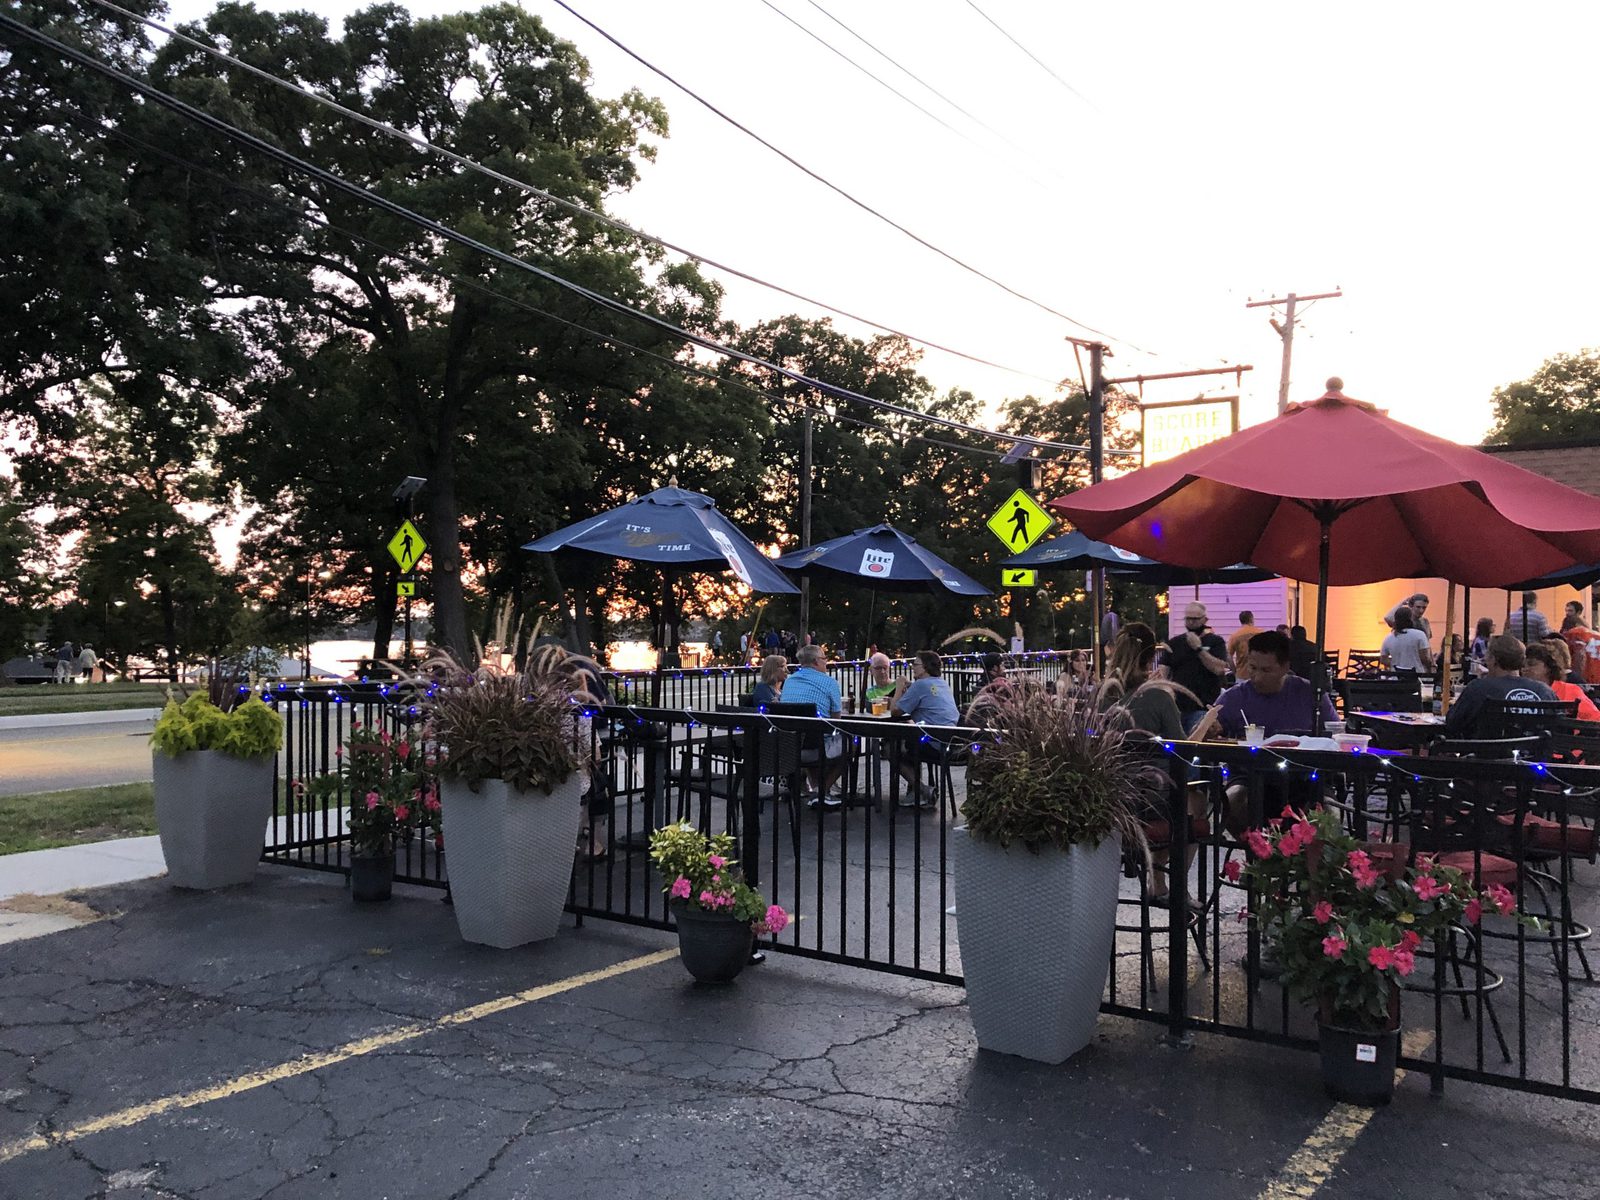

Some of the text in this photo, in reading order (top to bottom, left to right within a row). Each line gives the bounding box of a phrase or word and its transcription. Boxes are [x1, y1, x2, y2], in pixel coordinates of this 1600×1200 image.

[1152, 411, 1222, 431] SCORE
[1152, 433, 1219, 453] BOAR
[625, 524, 651, 533] IT'S
[657, 543, 691, 552] TIME
[866, 553, 891, 564] Lite
